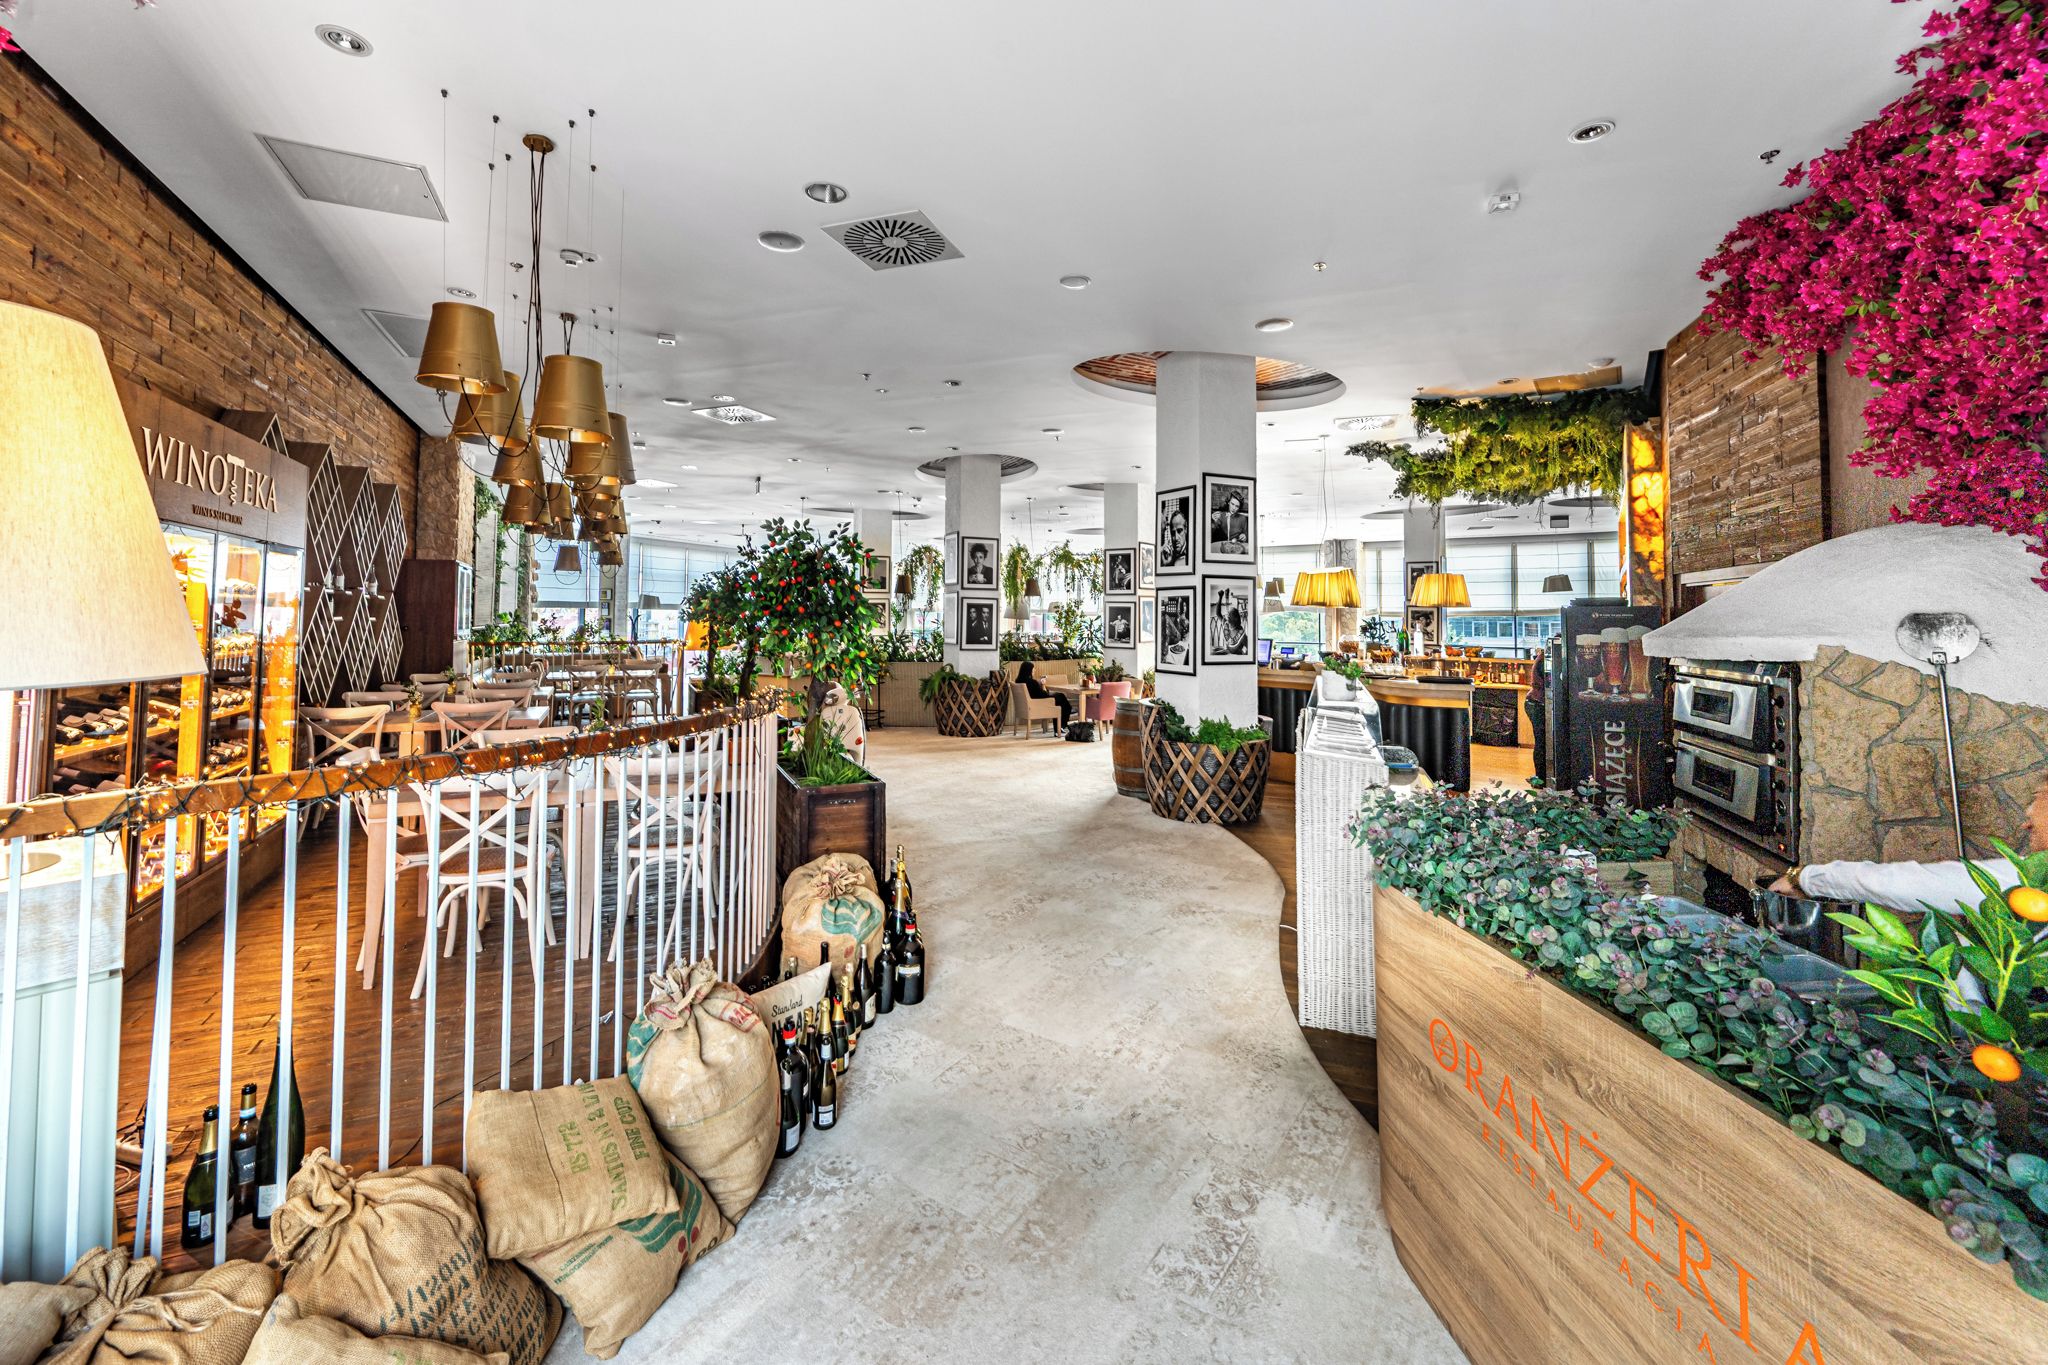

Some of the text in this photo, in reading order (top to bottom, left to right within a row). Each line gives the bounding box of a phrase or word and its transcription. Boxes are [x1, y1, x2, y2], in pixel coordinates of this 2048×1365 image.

[141, 426, 279, 513] WINOTEKA
[1600, 720, 1633, 811] SIĄŻĘCE
[614, 1096, 650, 1160] FINE CUP
[600, 1142, 628, 1211] SANTOS
[1429, 1018, 1826, 1365] ORANŻERIA
[411, 1275, 471, 1337] INDIA
